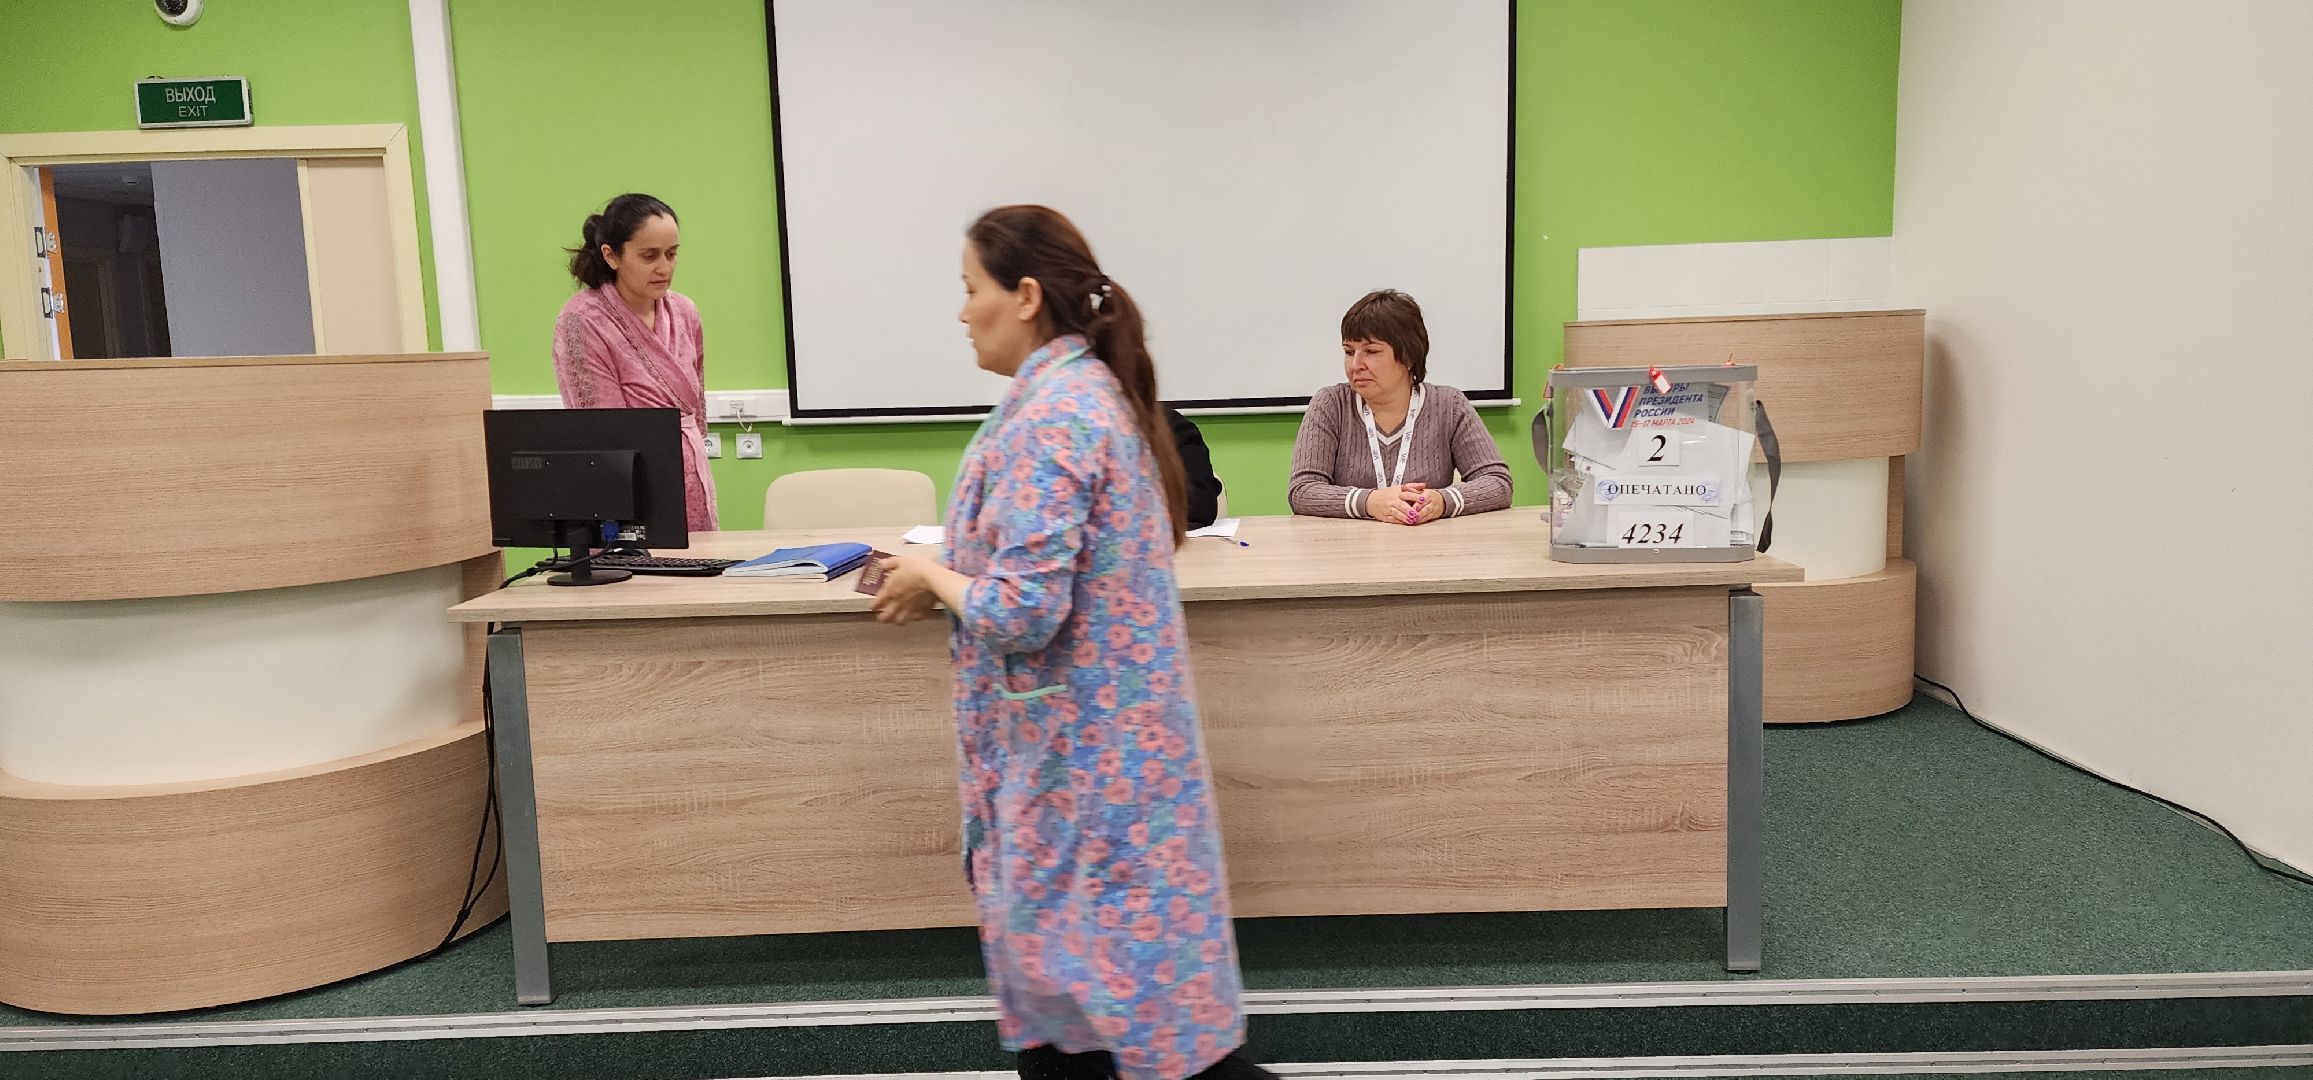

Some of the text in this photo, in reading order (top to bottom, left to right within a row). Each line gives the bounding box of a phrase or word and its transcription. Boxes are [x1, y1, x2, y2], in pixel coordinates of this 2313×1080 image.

[165, 86, 216, 104] ВЫХОД
[179, 105, 208, 117] EXIT
[1643, 383, 1690, 394] ВЫРЫ
[1639, 394, 1703, 405] ПРЕЗИДЕНТА
[1634, 407, 1676, 418] РОССИИ
[1651, 418, 1676, 427] МАРТА
[1647, 434, 1666, 462] 2
[1608, 484, 1706, 495] ОПЕЧАТАНО
[1621, 523, 1684, 544] 4234
